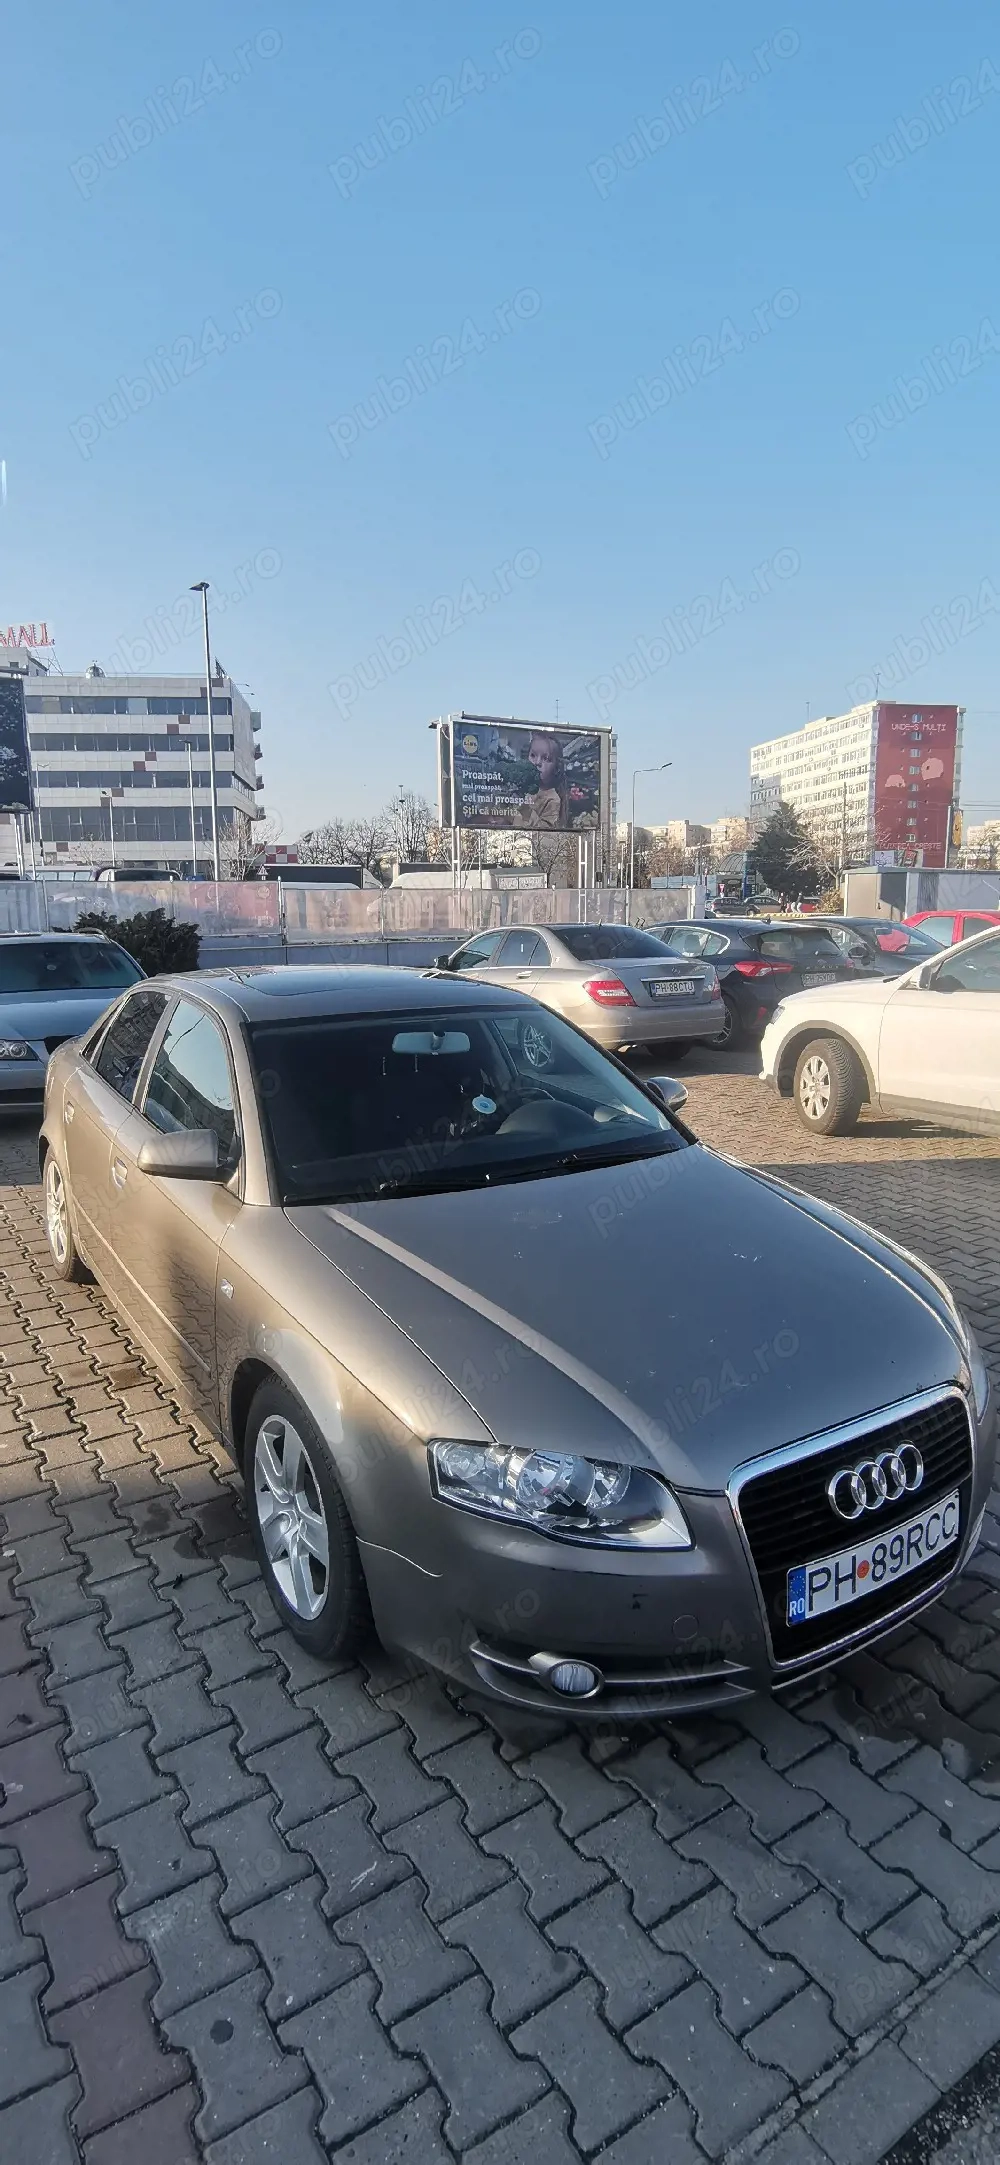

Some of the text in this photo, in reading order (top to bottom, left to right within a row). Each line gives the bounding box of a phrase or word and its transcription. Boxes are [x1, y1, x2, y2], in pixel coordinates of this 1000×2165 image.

[462, 793, 476, 803] cel
[477, 793, 494, 803] mai
[788, 1597, 806, 1618] RO
